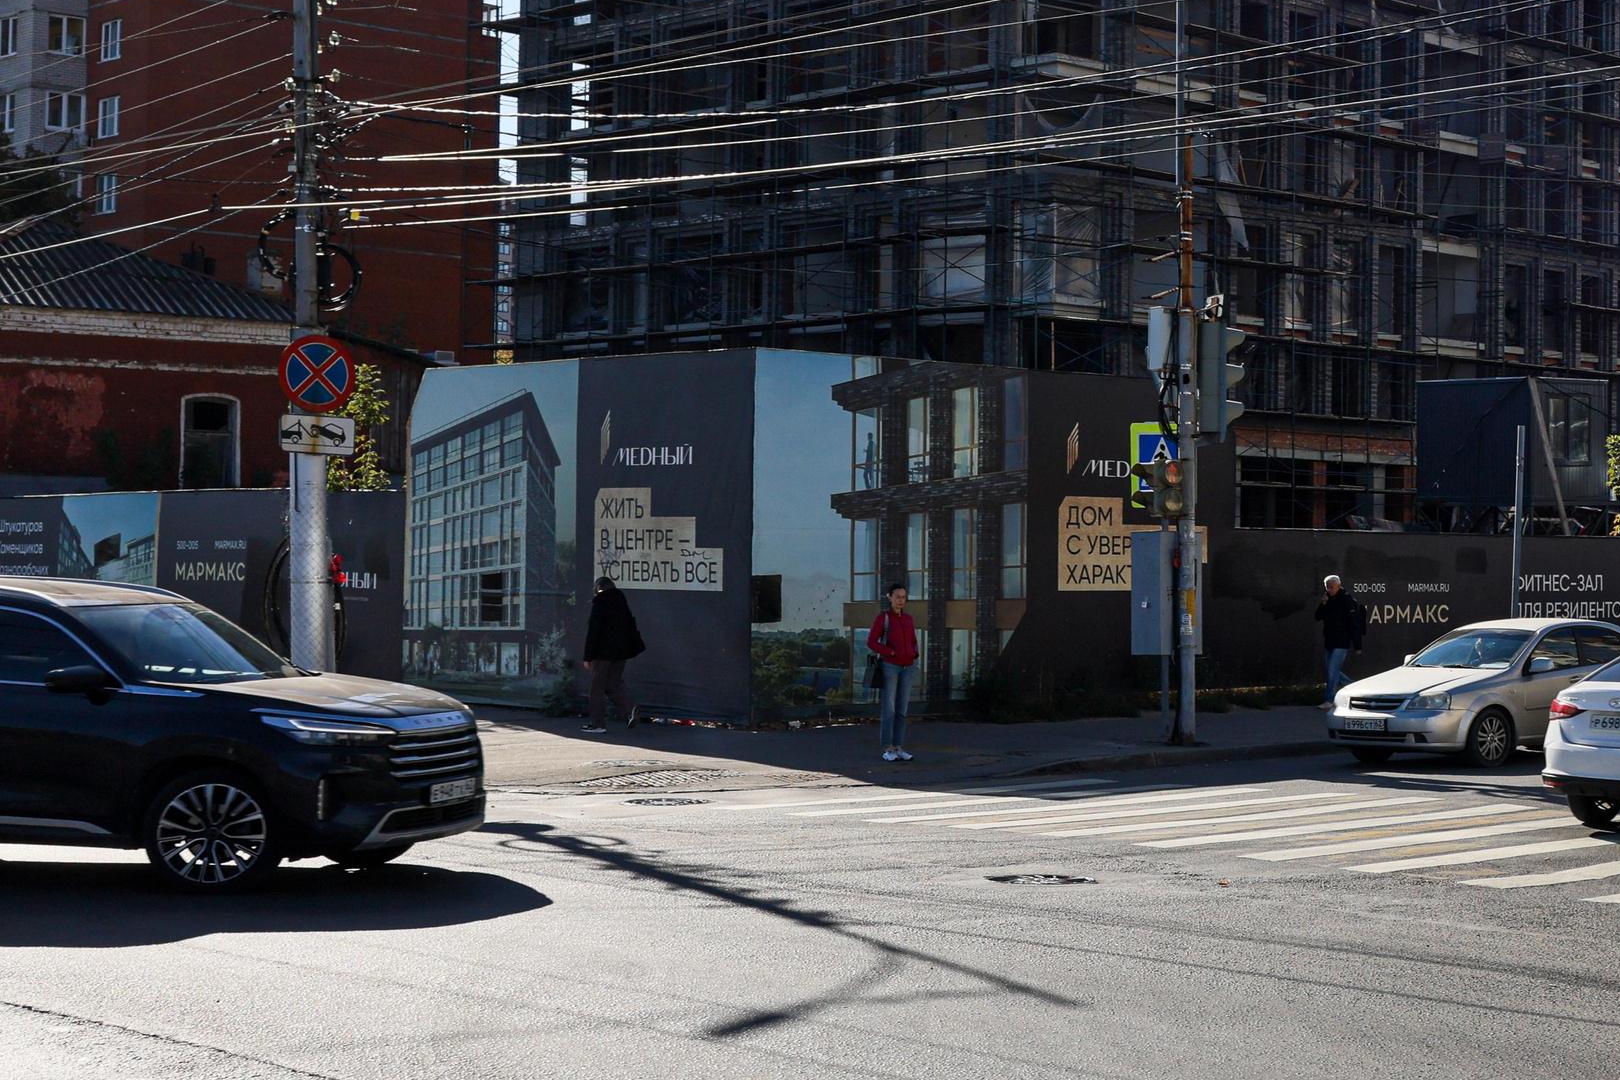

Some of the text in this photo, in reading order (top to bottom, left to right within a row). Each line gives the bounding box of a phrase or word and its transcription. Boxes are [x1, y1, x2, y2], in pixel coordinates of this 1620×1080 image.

[600, 497, 644, 519] ЖИТЬ
[1066, 506, 1113, 529] ДОМ
[0, 543, 43, 556] аменщиков
[600, 530, 610, 550] В
[614, 529, 674, 553] ЦЕНТРЕ
[1066, 535, 1132, 556] С УВЕР
[175, 561, 246, 581] МАРМАКС
[598, 560, 718, 584] УСПЕВАТЬ ВСЕ
[1353, 582, 1450, 594] 500-005 MARMAX.RU
[1366, 604, 1450, 624] АРМАКС
